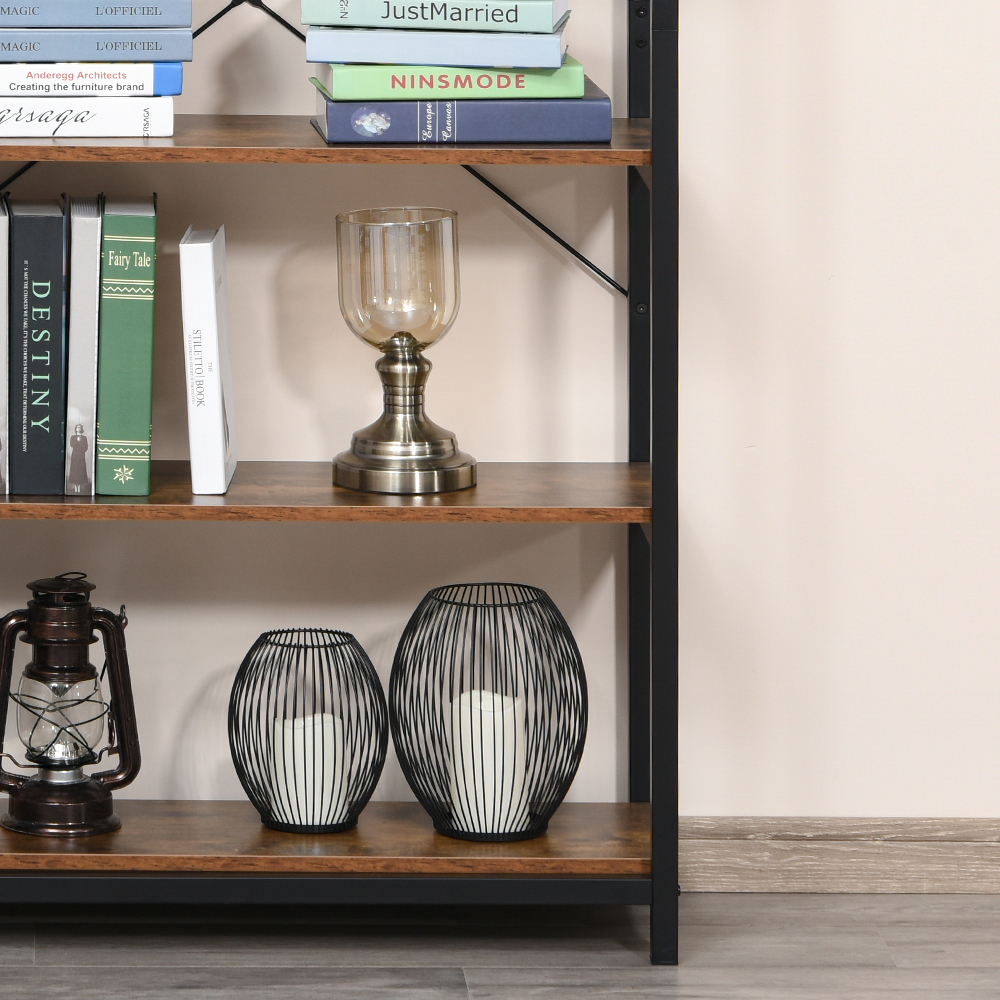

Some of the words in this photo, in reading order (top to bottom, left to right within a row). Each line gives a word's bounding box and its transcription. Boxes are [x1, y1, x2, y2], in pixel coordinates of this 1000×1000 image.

[0, 6, 40, 16] MAGIC
[95, 6, 162, 16] L'OFFICIEL
[381, 0, 519, 24] JustMarried
[0, 42, 41, 52] MAGIC
[95, 42, 163, 52] L'OFFICIEL
[26, 70, 74, 81] Anderegg
[77, 70, 127, 80] Architects
[391, 73, 526, 90] NINSMODE
[8, 82, 51, 93] Creating
[53, 82, 69, 92] the
[71, 82, 114, 92] furniture
[116, 82, 145, 92] brand
[421, 101, 434, 142] Europe
[441, 100, 452, 142] Canvas
[108, 250, 131, 271] Fairy
[132, 250, 151, 268] Tale
[31, 280, 51, 433] DESTINY
[192, 329, 203, 375] STILETTO
[195, 379, 206, 407] BOOK
